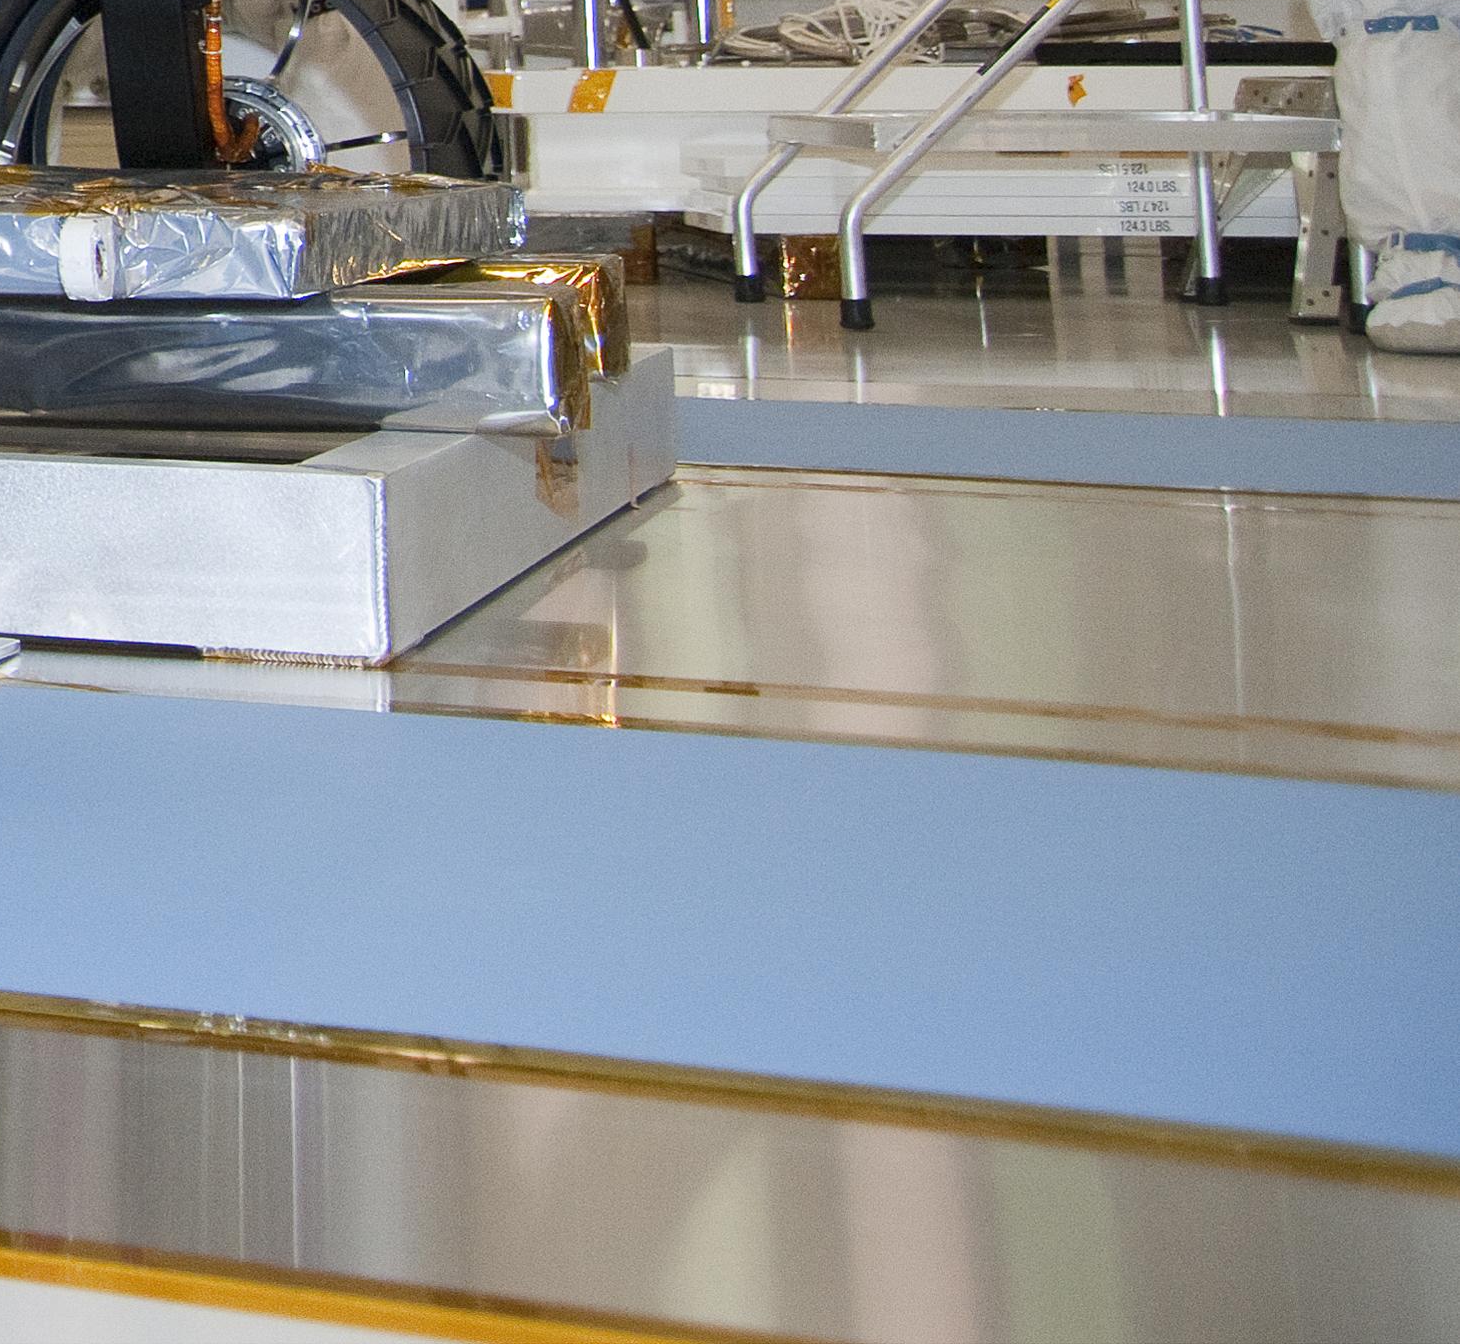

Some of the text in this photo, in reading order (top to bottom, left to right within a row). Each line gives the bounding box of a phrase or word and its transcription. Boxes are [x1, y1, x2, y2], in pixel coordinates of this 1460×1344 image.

[1126, 180, 1154, 193] 124.0
[1142, 200, 1170, 213] 124.7
[1120, 220, 1147, 232] 124.3
